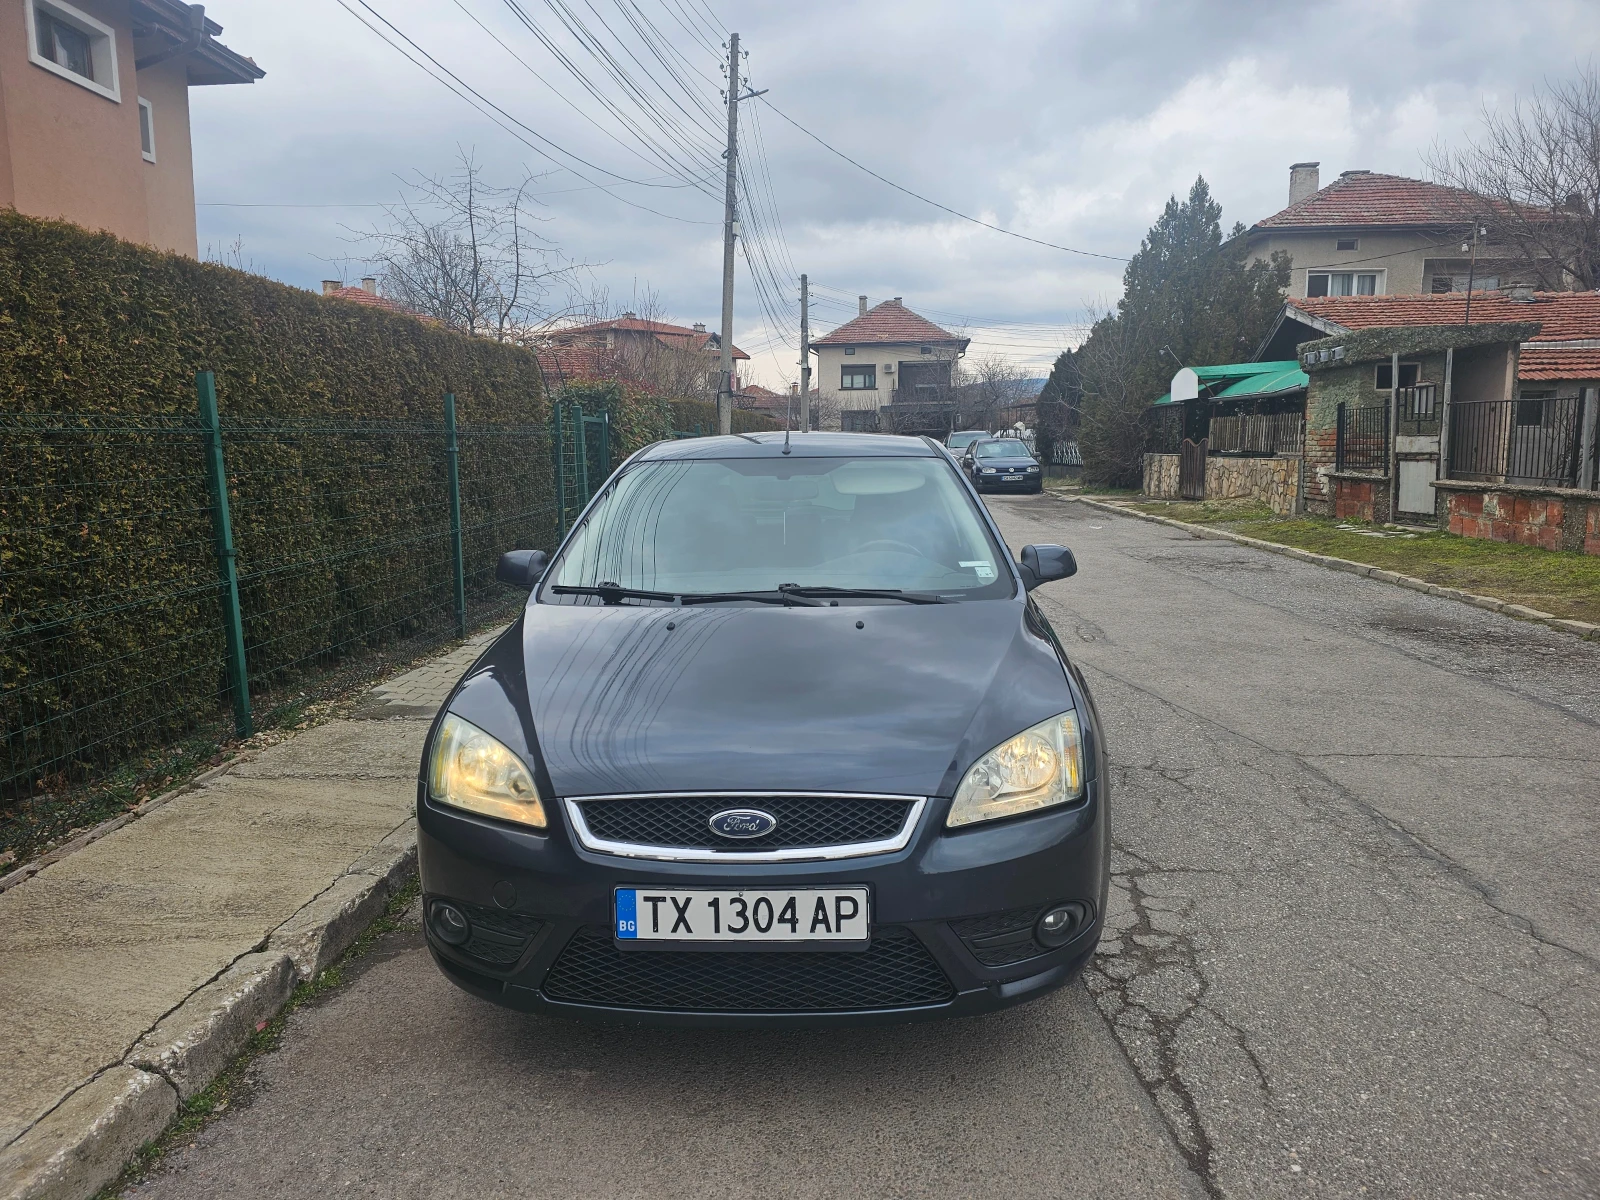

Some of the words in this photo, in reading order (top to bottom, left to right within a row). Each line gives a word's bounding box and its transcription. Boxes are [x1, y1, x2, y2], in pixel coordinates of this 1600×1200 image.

[723, 815, 760, 831] Ford
[643, 896, 693, 934] TX
[707, 896, 799, 934] 1304
[809, 895, 859, 934] AP
[619, 920, 635, 932] BG
